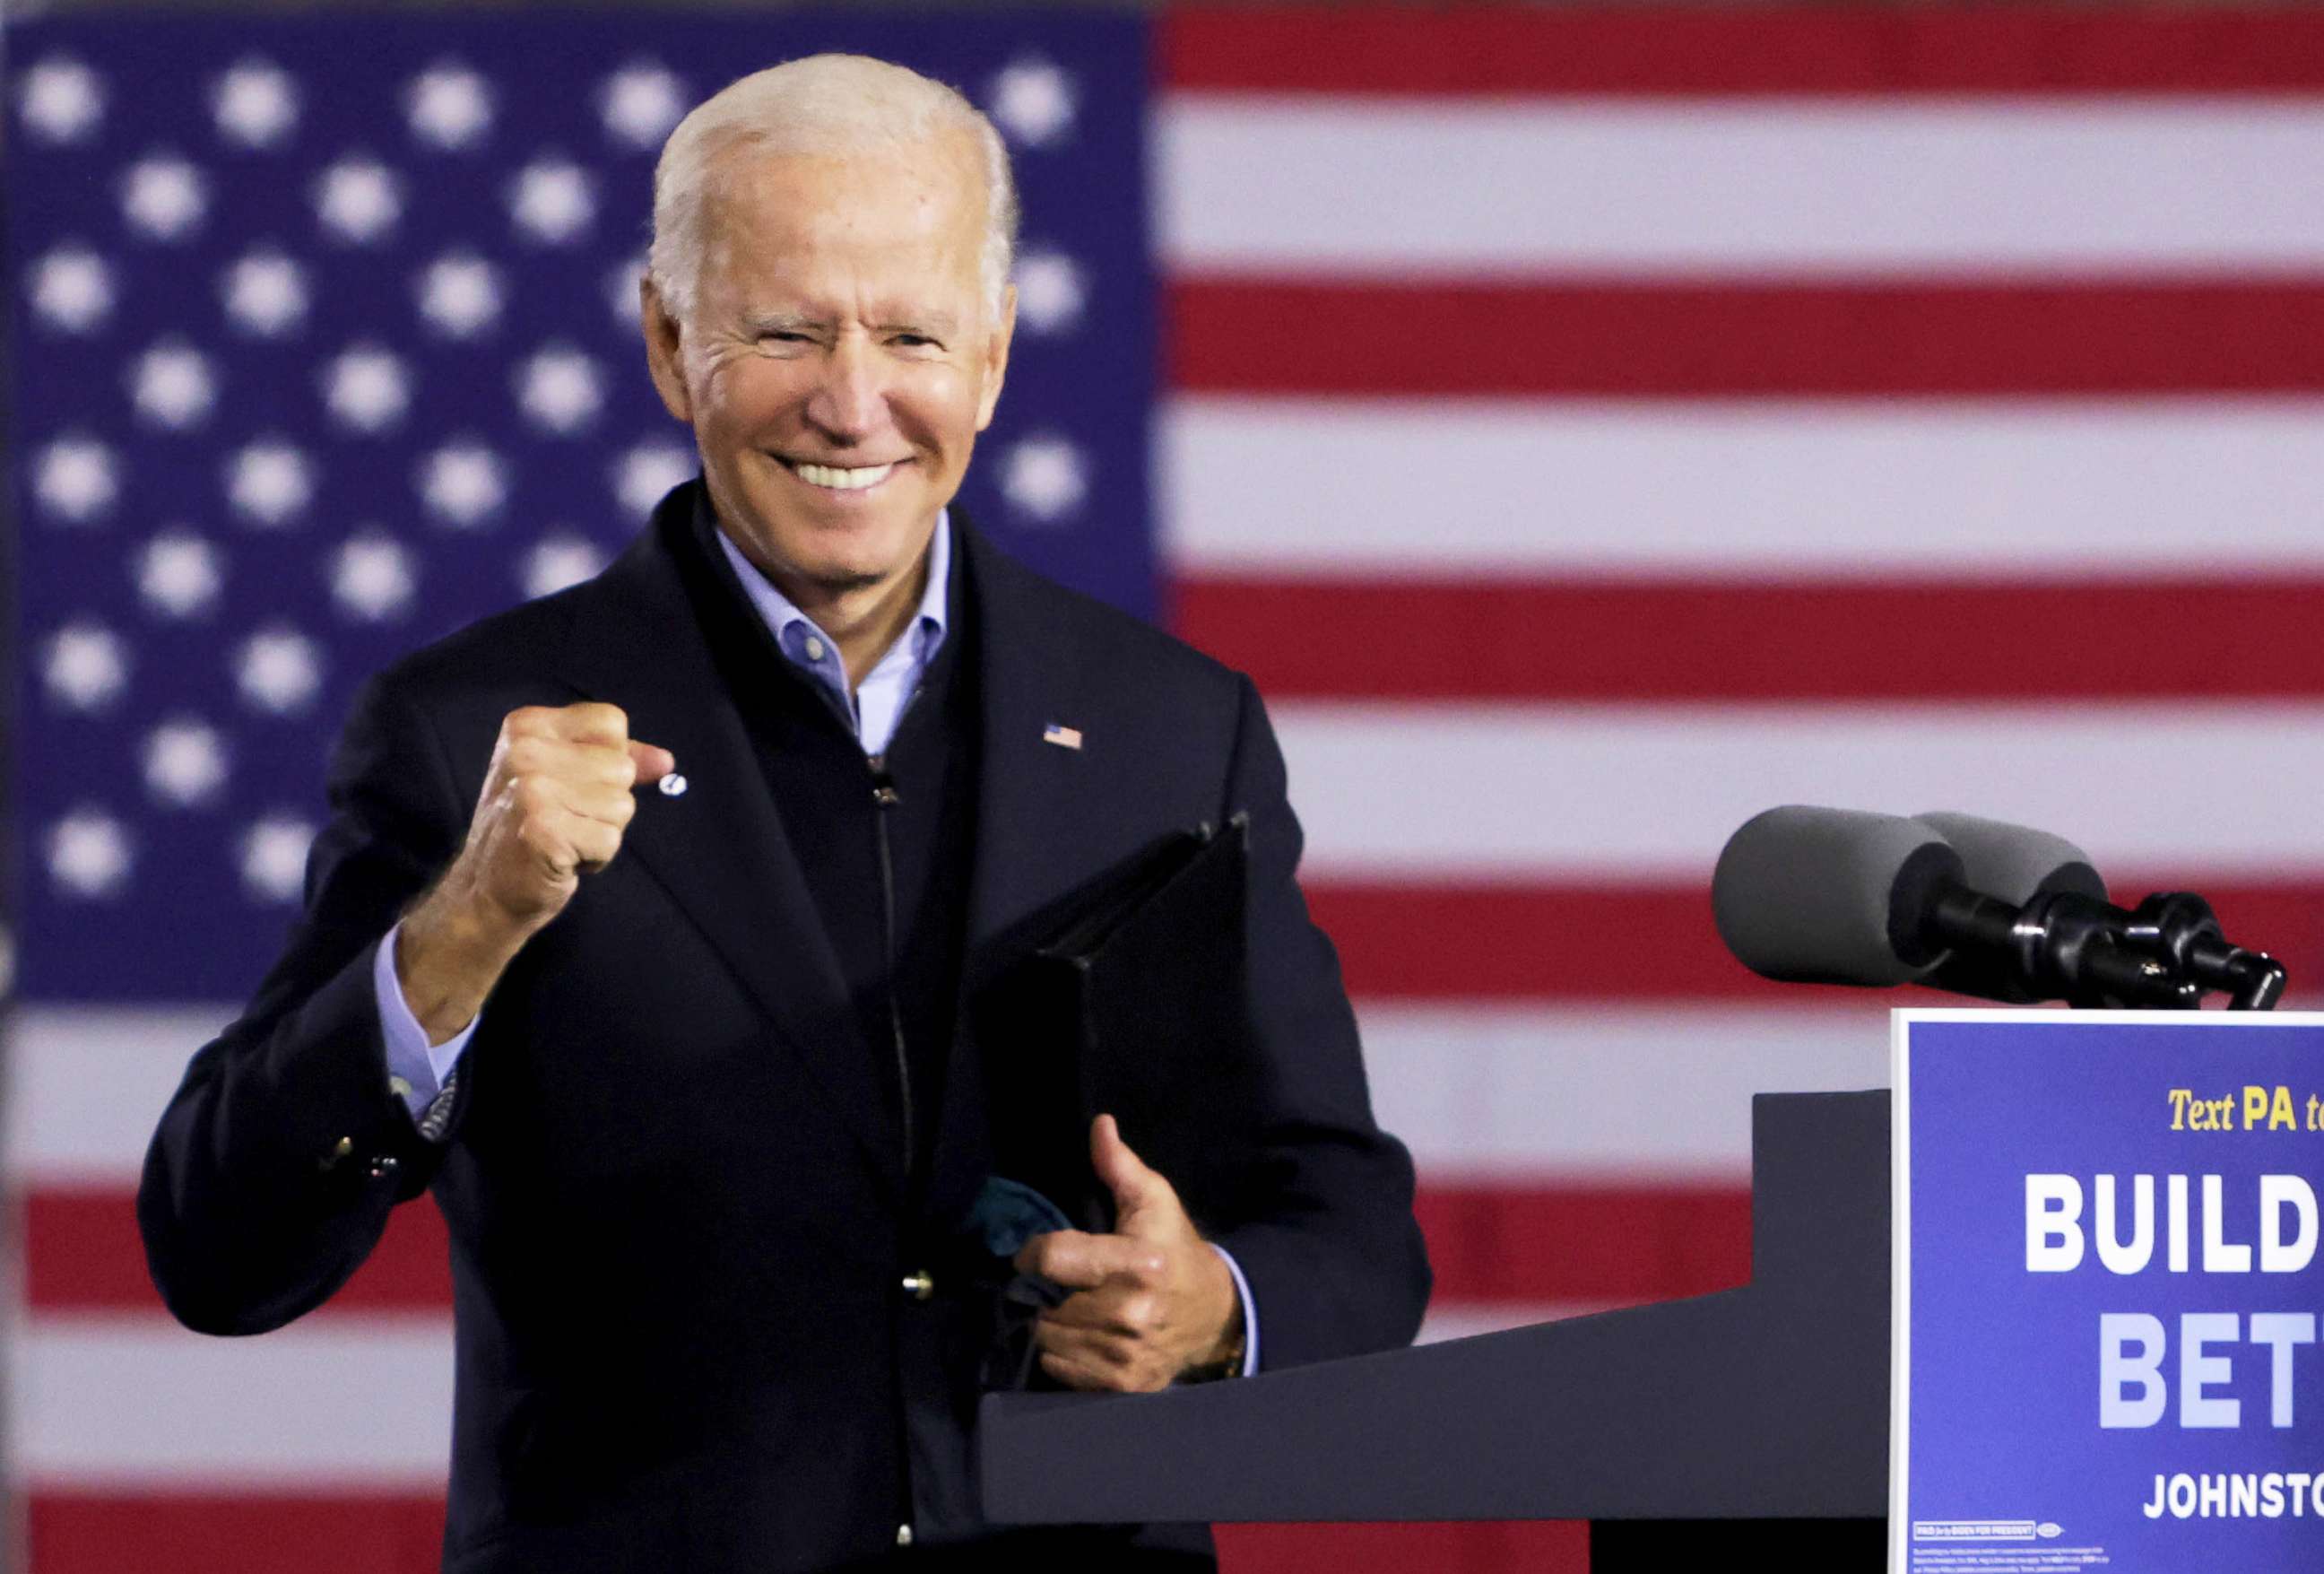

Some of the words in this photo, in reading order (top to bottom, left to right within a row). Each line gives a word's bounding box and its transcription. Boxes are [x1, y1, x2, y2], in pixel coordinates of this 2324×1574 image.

[2168, 1088, 2236, 1131] Text
[2242, 1085, 2297, 1131] PA
[2025, 1173, 2320, 1275] BUILD
[2099, 1312, 2324, 1430] BET
